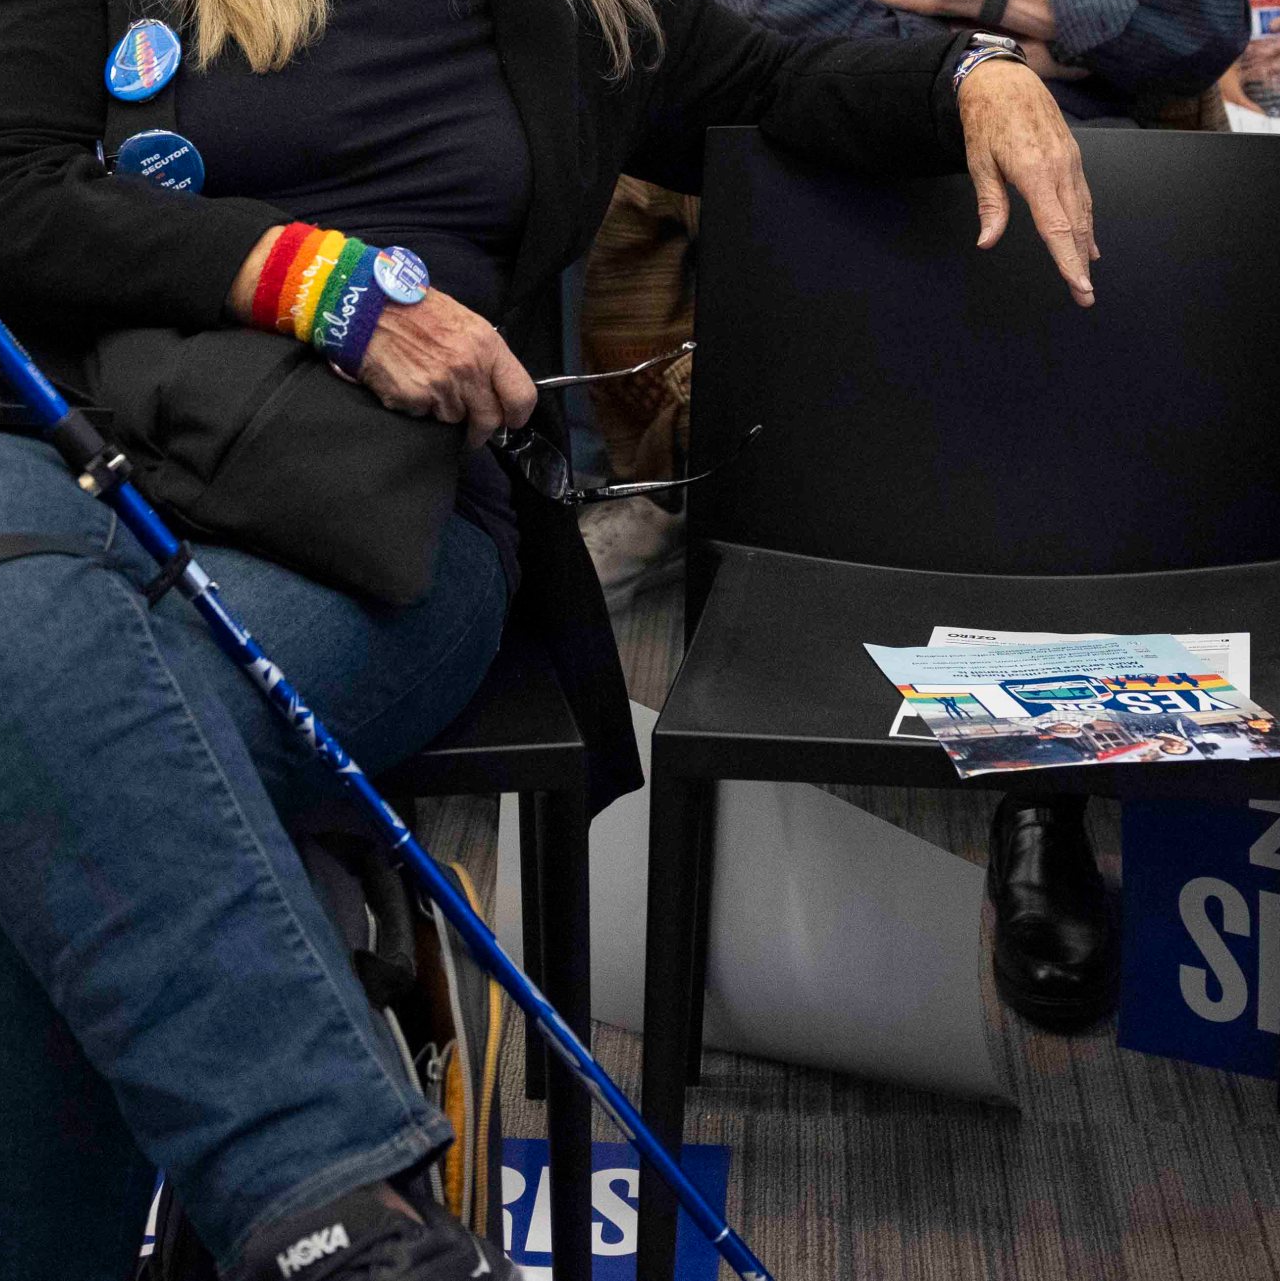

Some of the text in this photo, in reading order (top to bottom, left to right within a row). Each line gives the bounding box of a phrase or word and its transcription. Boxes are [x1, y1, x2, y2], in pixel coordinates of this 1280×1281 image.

[140, 153, 161, 167] The
[142, 146, 189, 176] SECUTOR
[160, 178, 176, 187] he
[314, 273, 369, 347] Pelosi
[947, 633, 997, 641] GZERO
[909, 682, 1032, 719] L
[1116, 689, 1236, 715] YES
[501, 1166, 639, 1257] RIS
[275, 1223, 351, 1279] HOKA
